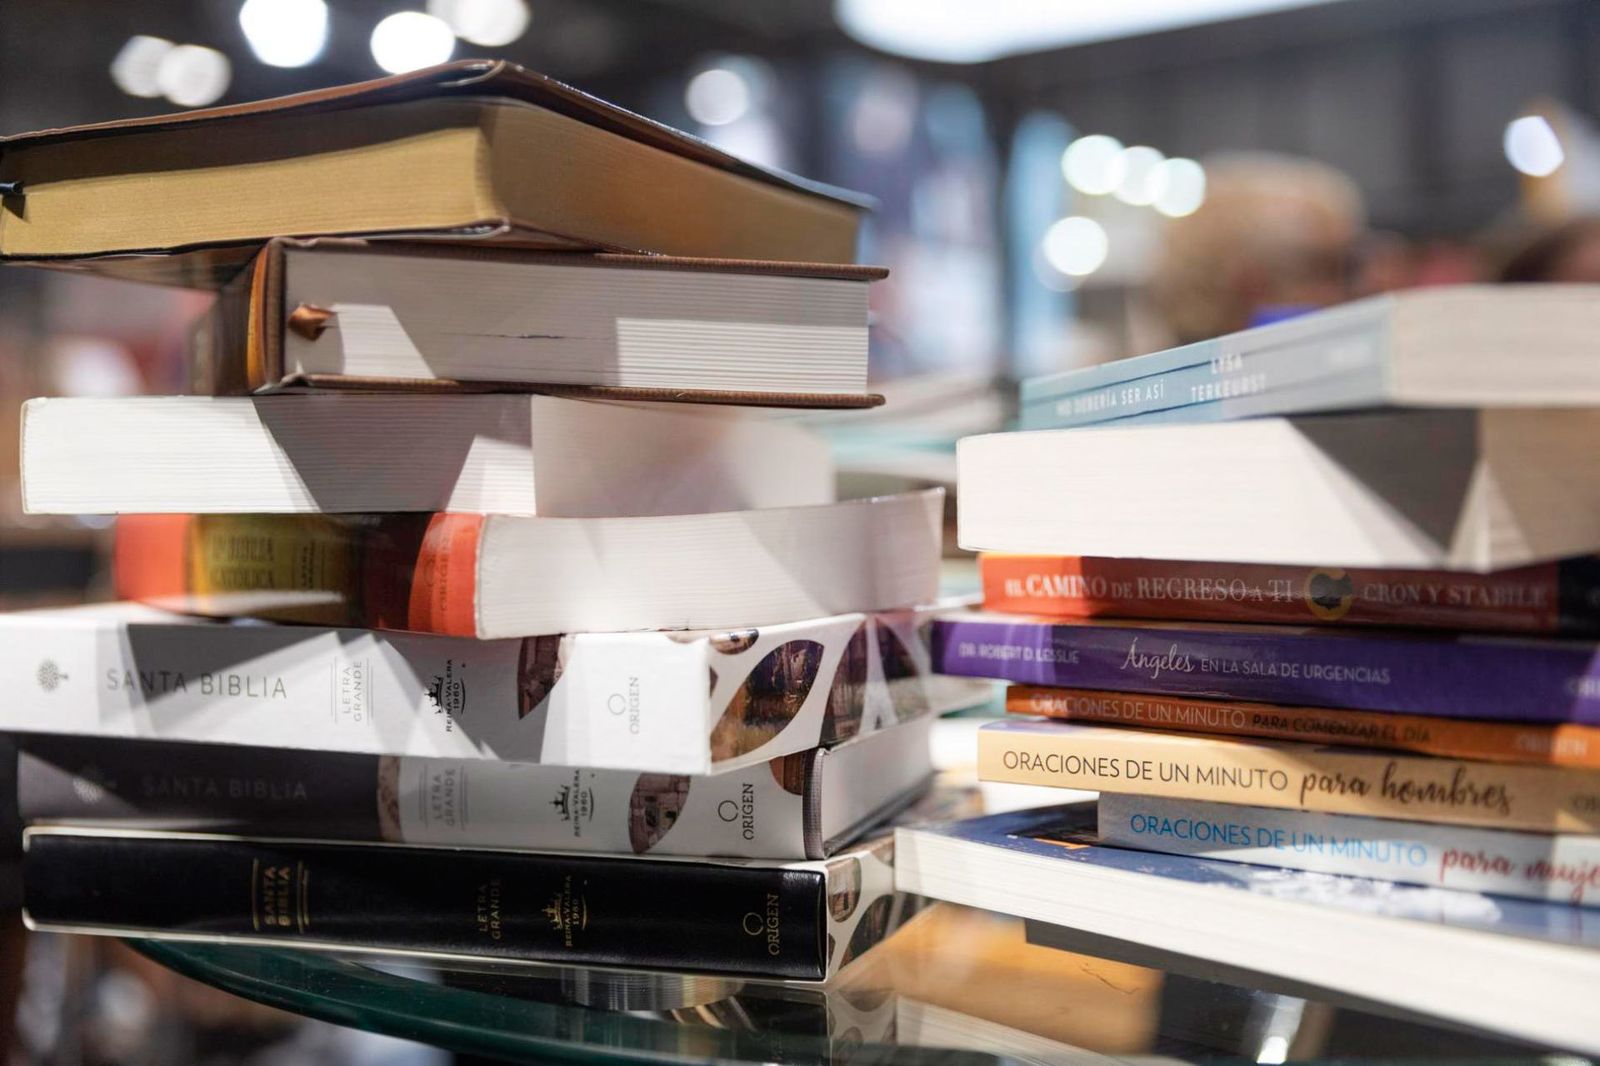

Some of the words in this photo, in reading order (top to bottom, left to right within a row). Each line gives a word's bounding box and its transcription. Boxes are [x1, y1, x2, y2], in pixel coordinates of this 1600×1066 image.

[1121, 387, 1143, 406] SER
[1146, 381, 1165, 401] ASÍ
[1026, 574, 1107, 599] CAMINO
[1111, 584, 1133, 599] DE
[1138, 578, 1248, 602] REGRESO
[1250, 587, 1264, 602] A
[1268, 578, 1293, 603] TI
[1364, 582, 1422, 602] CRON
[1422, 584, 1439, 604] Y
[107, 668, 187, 693] SANTA
[200, 674, 287, 699] BIBLIA
[1120, 637, 1195, 679] Ángeles
[1201, 658, 1218, 672] EN
[1223, 660, 1239, 673] LA
[1242, 661, 1278, 675] SALA
[1281, 662, 1299, 678] DE
[1303, 664, 1391, 684] URGENCIAS
[342, 665, 352, 714] LETRA
[353, 660, 363, 722] GRANDE
[453, 682, 461, 710] 1960
[629, 676, 640, 735] ORIGEN
[1030, 693, 1120, 718] ORACIONES
[1122, 699, 1145, 720] DE
[1148, 702, 1172, 721] UN
[1176, 704, 1246, 729] MINUTO
[1252, 715, 1288, 729] PARA
[1292, 717, 1377, 737] COMENZAR
[433, 774, 443, 820] LETRA
[446, 768, 456, 827] GRANDE
[1002, 751, 1120, 778] ORACIONES
[1126, 759, 1152, 781] DE
[1159, 762, 1189, 783] UN
[1196, 765, 1288, 791] MINUTO
[1299, 774, 1371, 806] para
[1381, 760, 1516, 816] hombres
[743, 783, 754, 841] ORIGEN
[1130, 814, 1250, 846] ORACIONES
[1257, 828, 1285, 850] DE
[1292, 833, 1324, 853] UN
[1330, 836, 1428, 866] MINUTO
[1438, 848, 1517, 882] para
[477, 884, 488, 933] LETRA
[768, 893, 780, 956] ORIGEN
